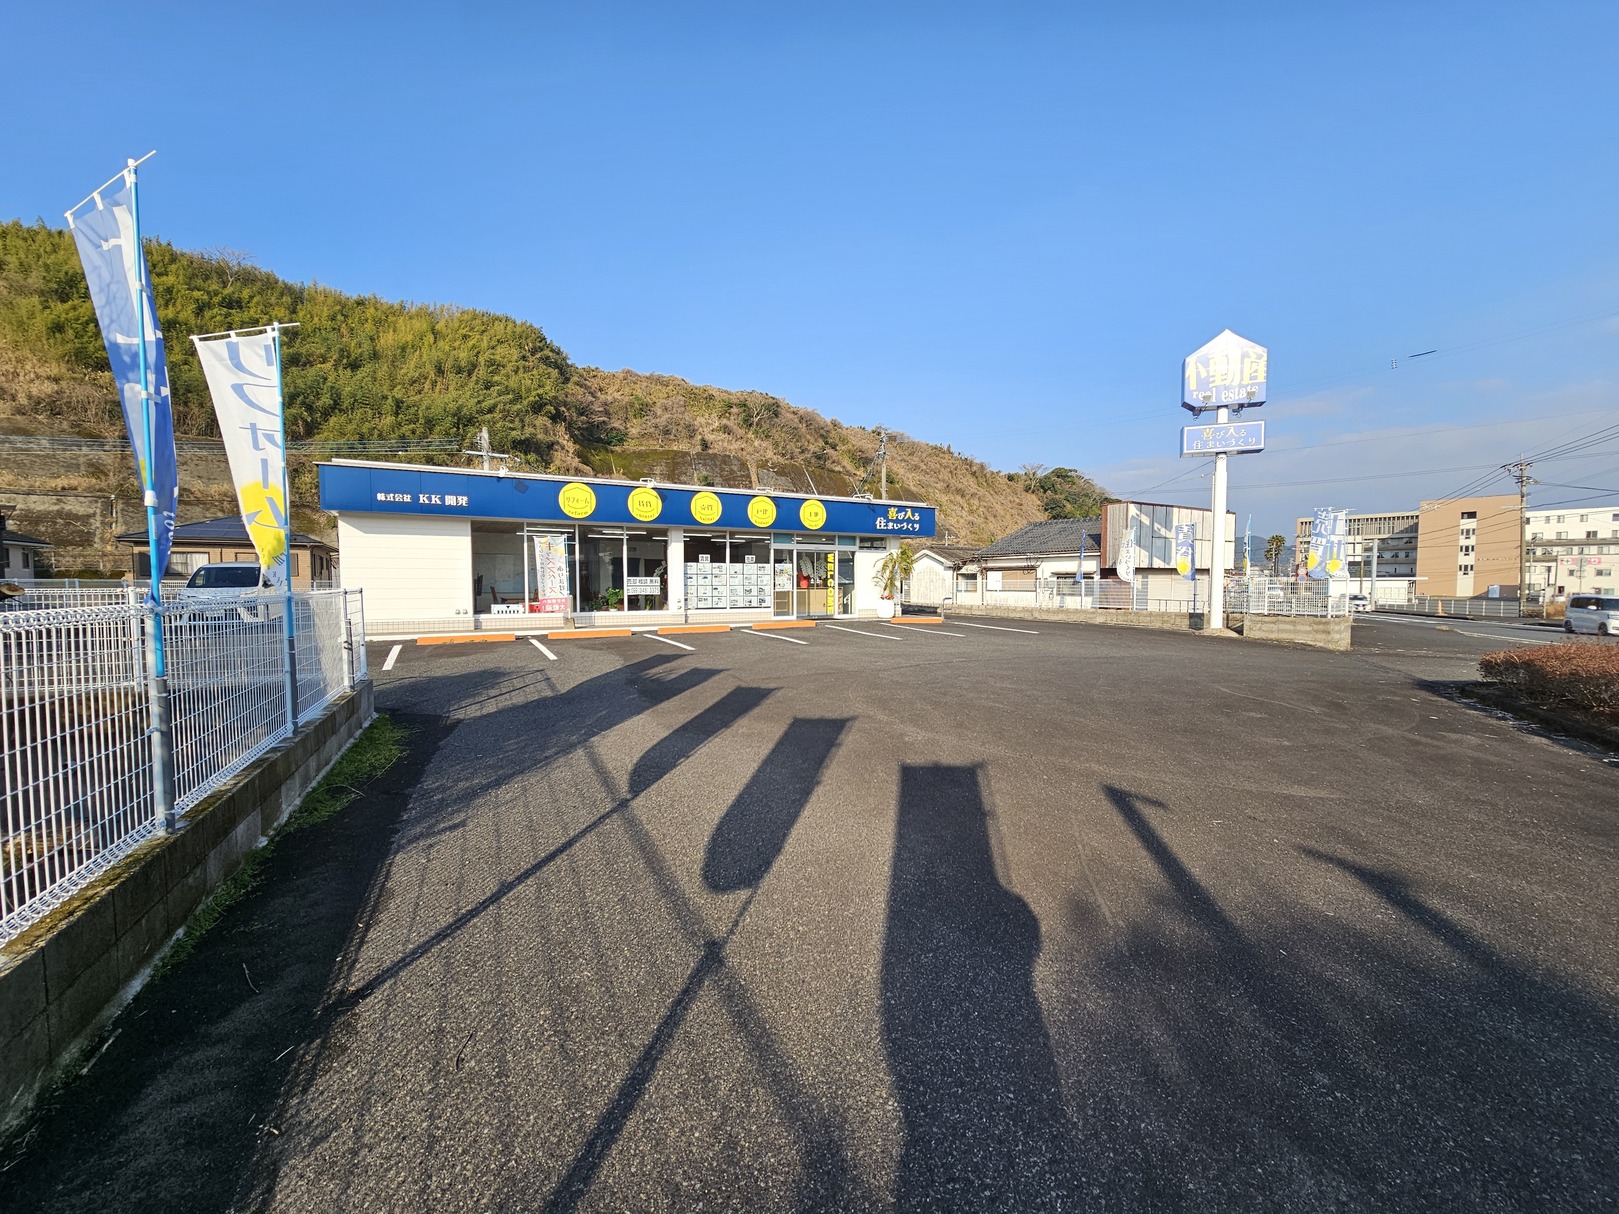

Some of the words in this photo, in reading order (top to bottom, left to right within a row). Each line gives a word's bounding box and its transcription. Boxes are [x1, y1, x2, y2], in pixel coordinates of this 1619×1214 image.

[1202, 426, 1247, 441] 喜び入る
[1192, 437, 1256, 450] 住まいづくり
[376, 493, 412, 502] 株式会社
[419, 494, 442, 504] KK
[445, 495, 468, 506] 開発
[888, 507, 920, 520] 喜び入る
[875, 517, 919, 531] 住まいづくり
[827, 553, 835, 615] WELCOME
